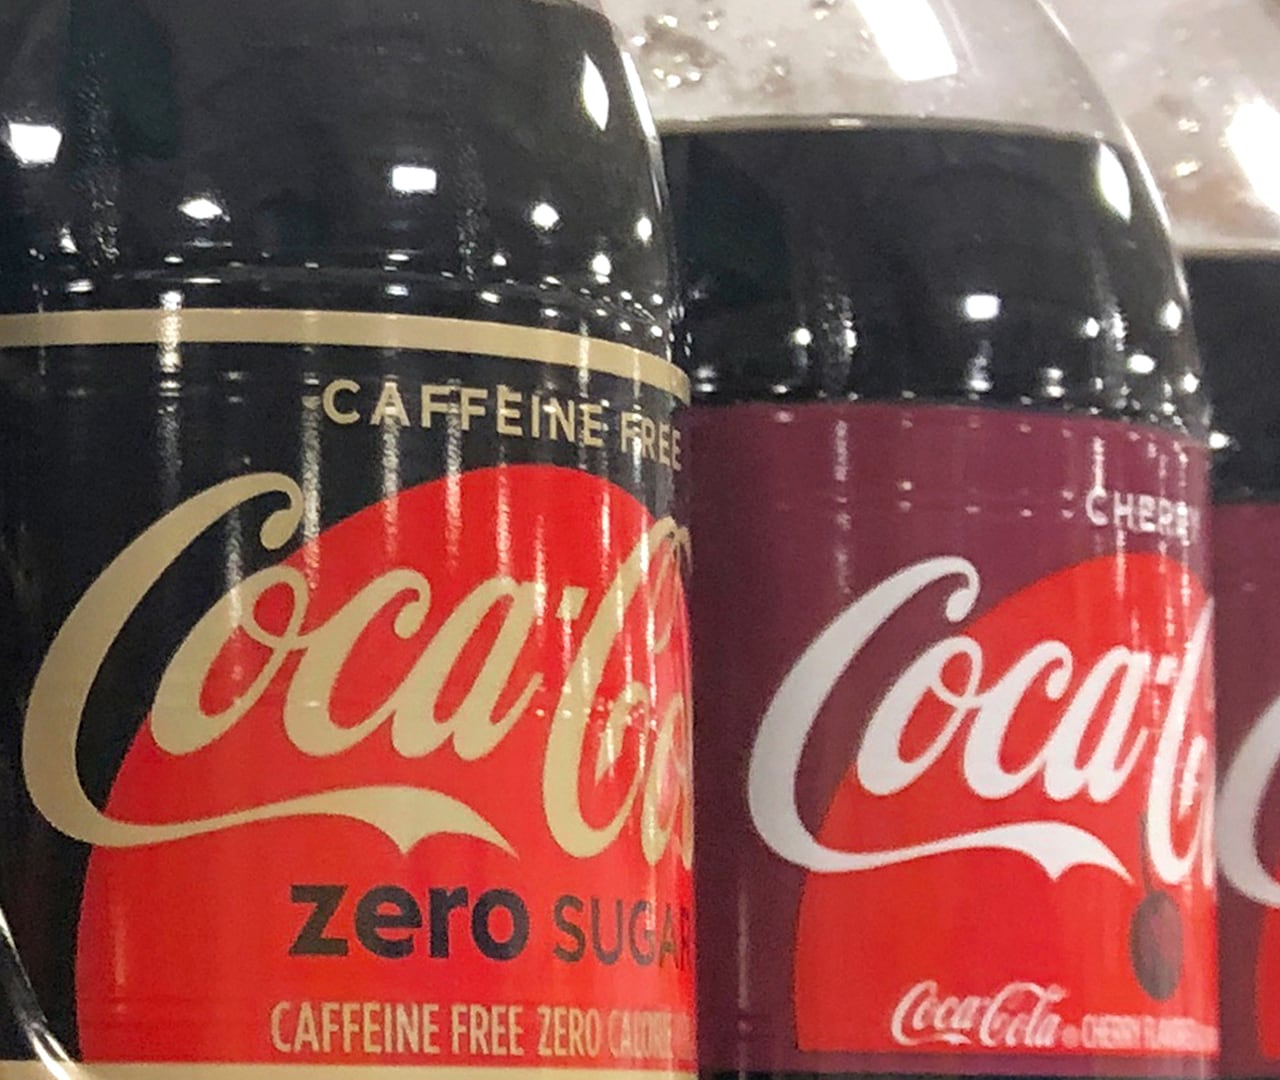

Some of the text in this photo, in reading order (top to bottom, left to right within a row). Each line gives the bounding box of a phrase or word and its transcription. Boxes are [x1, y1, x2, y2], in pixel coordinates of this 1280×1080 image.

[322, 379, 682, 471] CAFFEINE FREE
[288, 884, 530, 962] zero
[270, 1000, 440, 1054] CAFFEINE
[452, 1003, 525, 1056] FREE
[537, 1005, 602, 1058] ZERO
